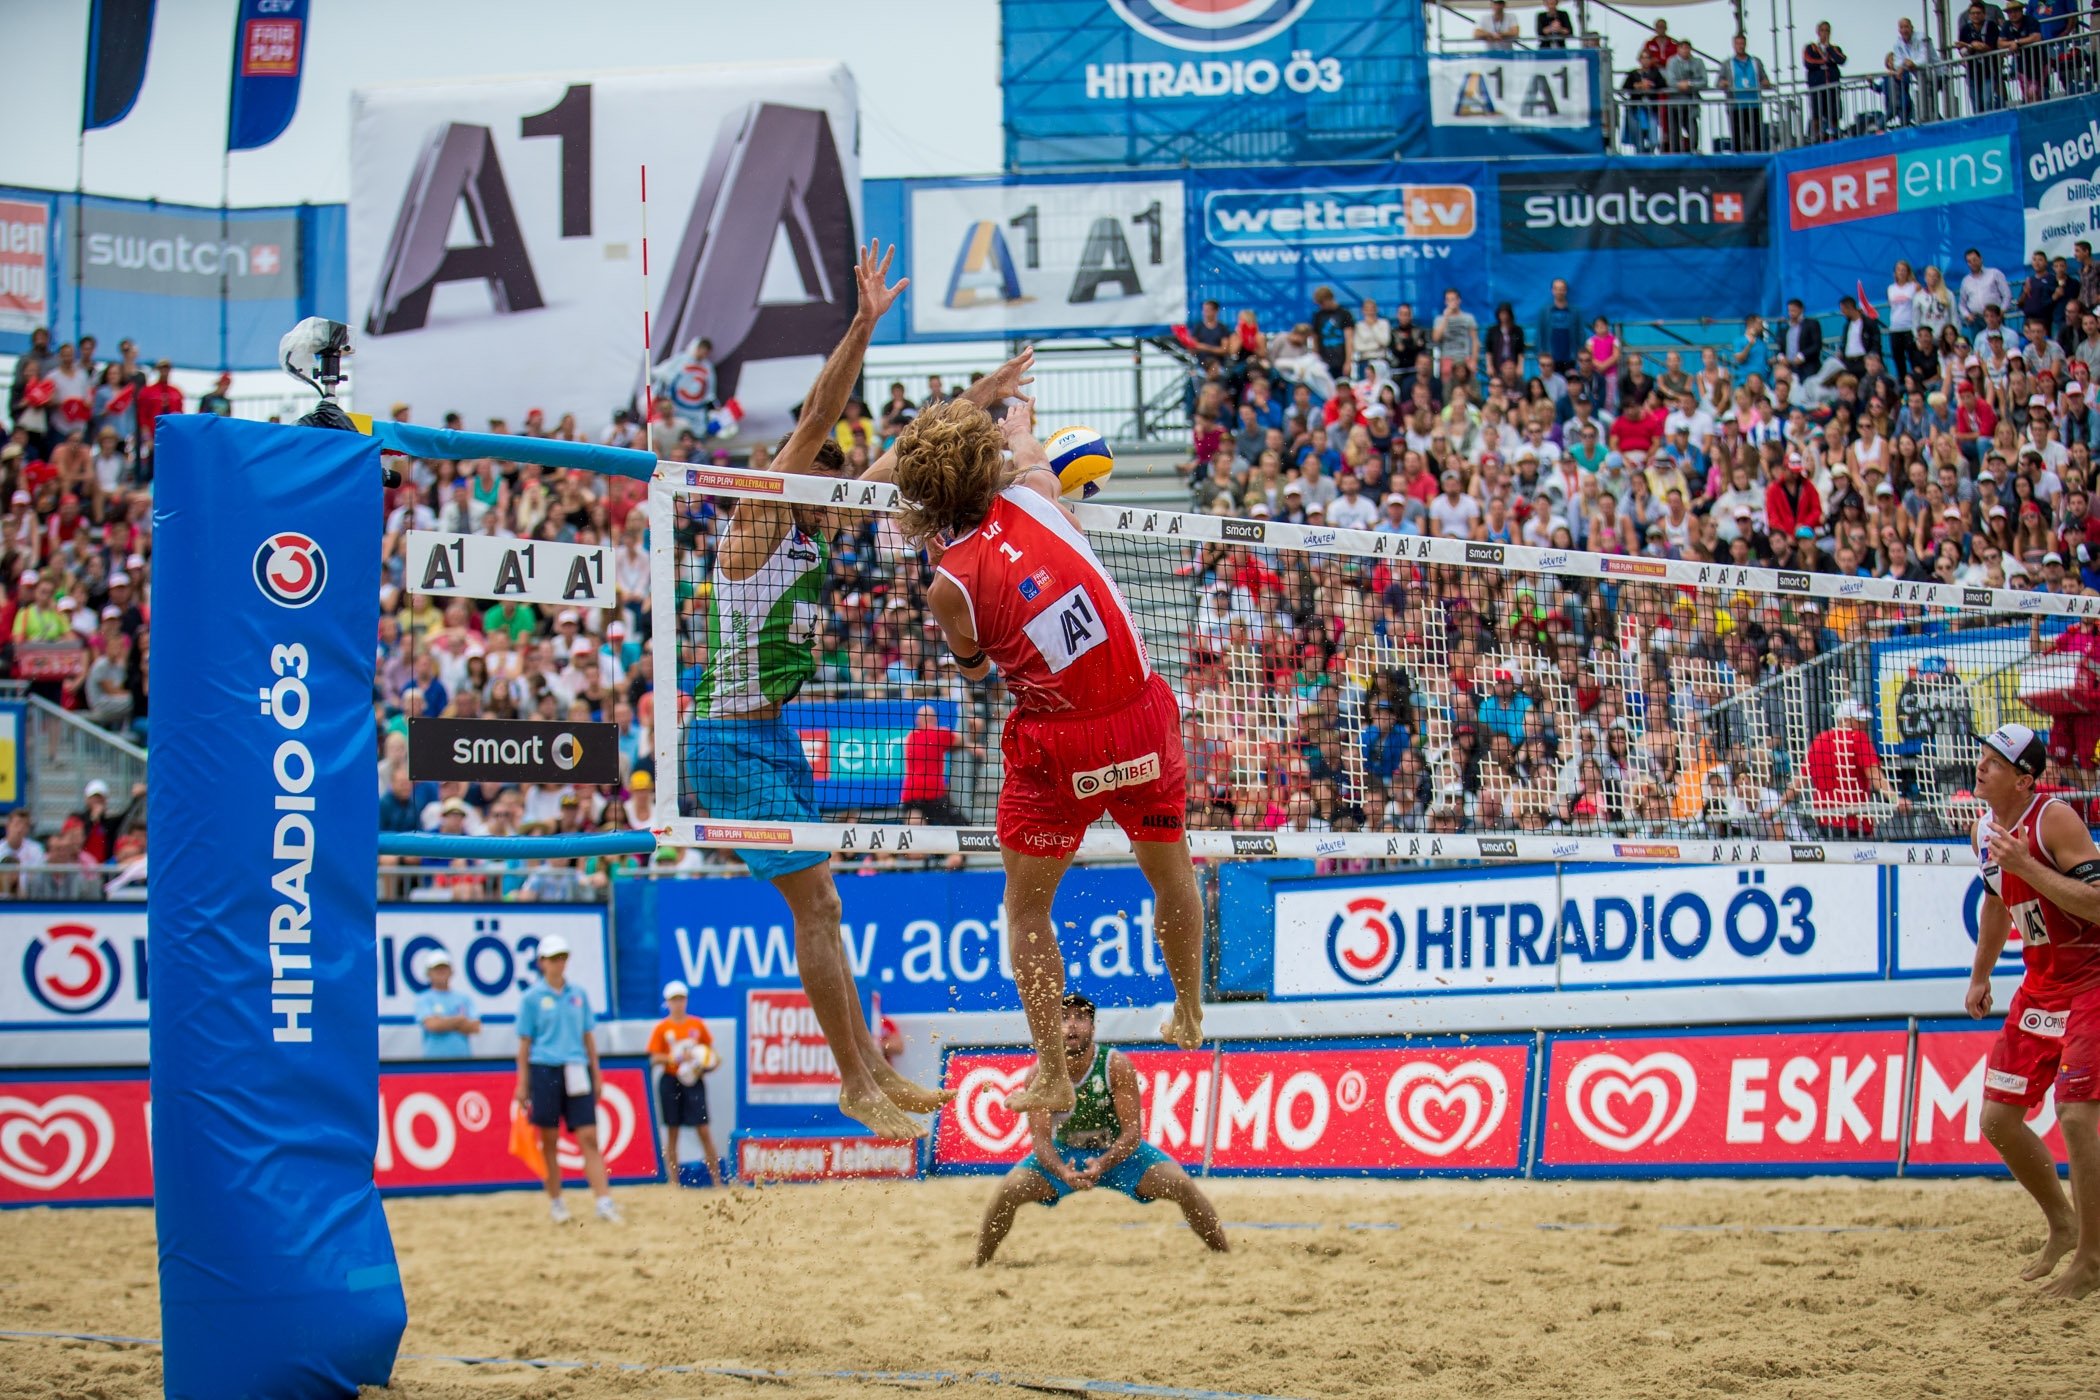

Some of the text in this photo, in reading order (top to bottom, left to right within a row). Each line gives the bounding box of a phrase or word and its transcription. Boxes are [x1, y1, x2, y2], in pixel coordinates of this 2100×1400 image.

[251, 27, 295, 43] FAIR
[250, 45, 294, 61] PLAY
[1086, 51, 1343, 98] HITRADIO Ö3
[1453, 66, 1569, 117] A1 A1
[1796, 150, 2003, 217] ORF eins
[364, 84, 592, 336] A1
[1215, 198, 1465, 232] wetter.tv
[1524, 186, 1709, 228] swatch
[88, 233, 250, 277] swatch
[941, 202, 1162, 307] A1 A1
[1233, 243, 1451, 264] www.wetter.tv
[699, 474, 781, 491] FAIR PLAY VOLLEYBALL WAY
[831, 481, 899, 507] A1 A1 A
[1117, 511, 1182, 534] A1 A1 A1
[1225, 524, 1252, 537] smart
[999, 541, 1023, 563] 1
[1373, 535, 1431, 557] A1 A1 A1
[1469, 548, 1492, 560] smart
[421, 538, 603, 599] A1 A1 A1
[1032, 569, 1047, 582] FAIR
[1609, 562, 1621, 571] FAIR
[1621, 563, 1633, 571] PLAY
[1699, 566, 1747, 586] A1 A1 A1
[1036, 575, 1050, 588] PLAY
[1779, 577, 1800, 587] smart
[1892, 583, 1936, 601] A1 A1 A1
[1965, 592, 1984, 602] smart
[2066, 597, 2092, 614] A1 A1
[1060, 594, 1093, 656] A1
[453, 735, 543, 765] smart
[260, 642, 316, 1043] HITRADIO Ö3
[708, 828, 724, 838] FAIR
[724, 830, 742, 840] PLAY
[743, 831, 776, 841] VOLLEYBALL
[776, 832, 790, 842] WAY
[841, 827, 913, 850] A1 A1 A1
[961, 835, 991, 848] smart
[1236, 839, 1263, 850] smart
[1387, 836, 1443, 856] A1 A1 A1
[1481, 841, 1505, 853] smart
[1712, 843, 1760, 862] A1 A1 A1
[1794, 848, 1815, 860] smart
[1907, 846, 1950, 864] A1 A1 A1
[1416, 869, 1816, 970] HITRADIO Ö3
[2025, 904, 2046, 941] A1
[1136, 1069, 1331, 1151] KIMO
